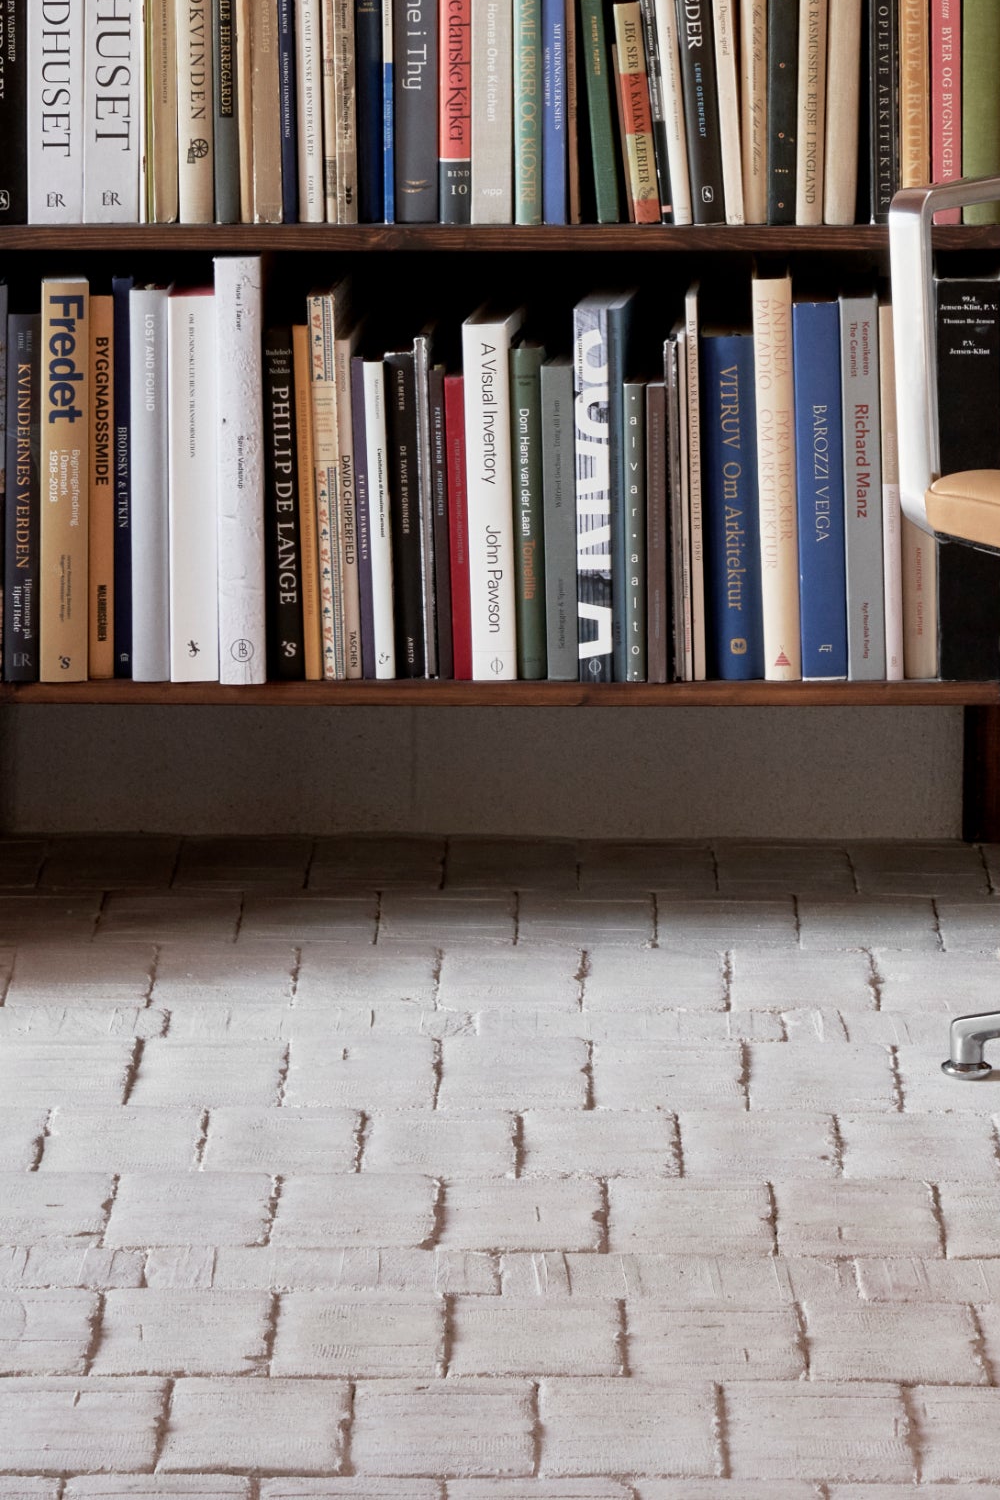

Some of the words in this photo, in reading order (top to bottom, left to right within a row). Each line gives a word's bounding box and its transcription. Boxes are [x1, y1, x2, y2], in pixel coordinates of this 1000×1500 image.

[7, 15, 15, 62] VADSTRUP
[303, 11, 312, 43] GAMLE
[487, 3, 498, 45] Homes
[624, 20, 634, 46] JEG
[878, 5, 889, 76] OPLEVE
[941, 27, 953, 62] BYER
[219, 24, 233, 115] HERREGÅRDE
[304, 45, 313, 84] DANSKE
[403, 44, 427, 90] Thy
[449, 14, 470, 81] danske
[487, 48, 498, 73] One
[519, 44, 537, 96] KIRKER
[627, 47, 638, 69] SER
[807, 10, 819, 88] RASMUSSEN:
[694, 62, 702, 83] LENE
[942, 67, 953, 87] OG
[445, 82, 470, 145] Kirker
[487, 76, 498, 122] Kitchen
[519, 101, 538, 131] OG
[805, 92, 818, 129] REJSE
[631, 91, 650, 183] KALKMALERIER
[879, 84, 890, 205] ARKITEKTUR
[904, 81, 922, 188] ARKITEKT
[941, 92, 953, 178] BYGNINGER
[307, 176, 315, 204] FORUM
[482, 188, 503, 197] vipp
[519, 138, 538, 204] KLOSTRE
[805, 142, 817, 204] ENGLAND
[145, 314, 154, 347] LOST
[481, 342, 496, 355] A
[757, 299, 771, 390] PALLADIO
[772, 299, 788, 379] ANDREA
[862, 321, 870, 376] Keramikeren
[48, 295, 84, 424] Fredet
[145, 350, 154, 369] AND
[850, 340, 858, 378] Ceramist
[146, 372, 155, 411] FOUND
[397, 386, 405, 411] MEYER
[481, 359, 497, 411] Visual
[719, 364, 740, 449] VITRUV
[16, 363, 32, 487] KVINDERNES
[95, 336, 109, 486] BYGGNADSSMIDE
[272, 386, 291, 474] PHILIP
[519, 408, 530, 433] Dom
[759, 408, 774, 442] OM
[775, 409, 791, 454] FYRA
[117, 426, 128, 478] BRODSKY
[399, 445, 407, 456] DE
[480, 415, 497, 485] Inventory
[519, 436, 531, 464] Hans
[813, 405, 829, 479] BAROZZI
[855, 404, 869, 467] Richard
[48, 449, 59, 503] 1918–2018
[61, 454, 69, 496] Danmark
[70, 449, 81, 527] Bygningsfredning
[118, 481, 126, 489] &
[342, 455, 352, 488] DAVID
[399, 458, 408, 484] TAVSE
[520, 467, 530, 487] van
[723, 461, 741, 499] Om
[118, 491, 129, 529] UTKIN
[276, 482, 293, 514] DE
[400, 486, 410, 534] BYGNINGER
[521, 489, 532, 507] der
[761, 448, 777, 570] ARKITEKTUR
[778, 462, 793, 542] BÖCKER
[815, 485, 830, 542] VEIGA
[857, 473, 870, 518] Manz
[15, 492, 31, 569] VERDEN
[342, 490, 355, 564] CHIPPERFIELD
[485, 525, 502, 563] John
[521, 510, 533, 536] Laan
[277, 520, 297, 604] LANGE
[724, 505, 746, 610] Arkitektur
[915, 547, 923, 591] ARCHITECTURE
[13, 609, 22, 632] Hede
[22, 579, 33, 621] Hjemmene
[487, 570, 504, 634] Pawson
[630, 553, 640, 655] aalto
[916, 601, 924, 636] SCULPTURE
[21, 623, 32, 640] på
[348, 630, 358, 668] TASCHEN
[407, 636, 415, 664] ARISTO
